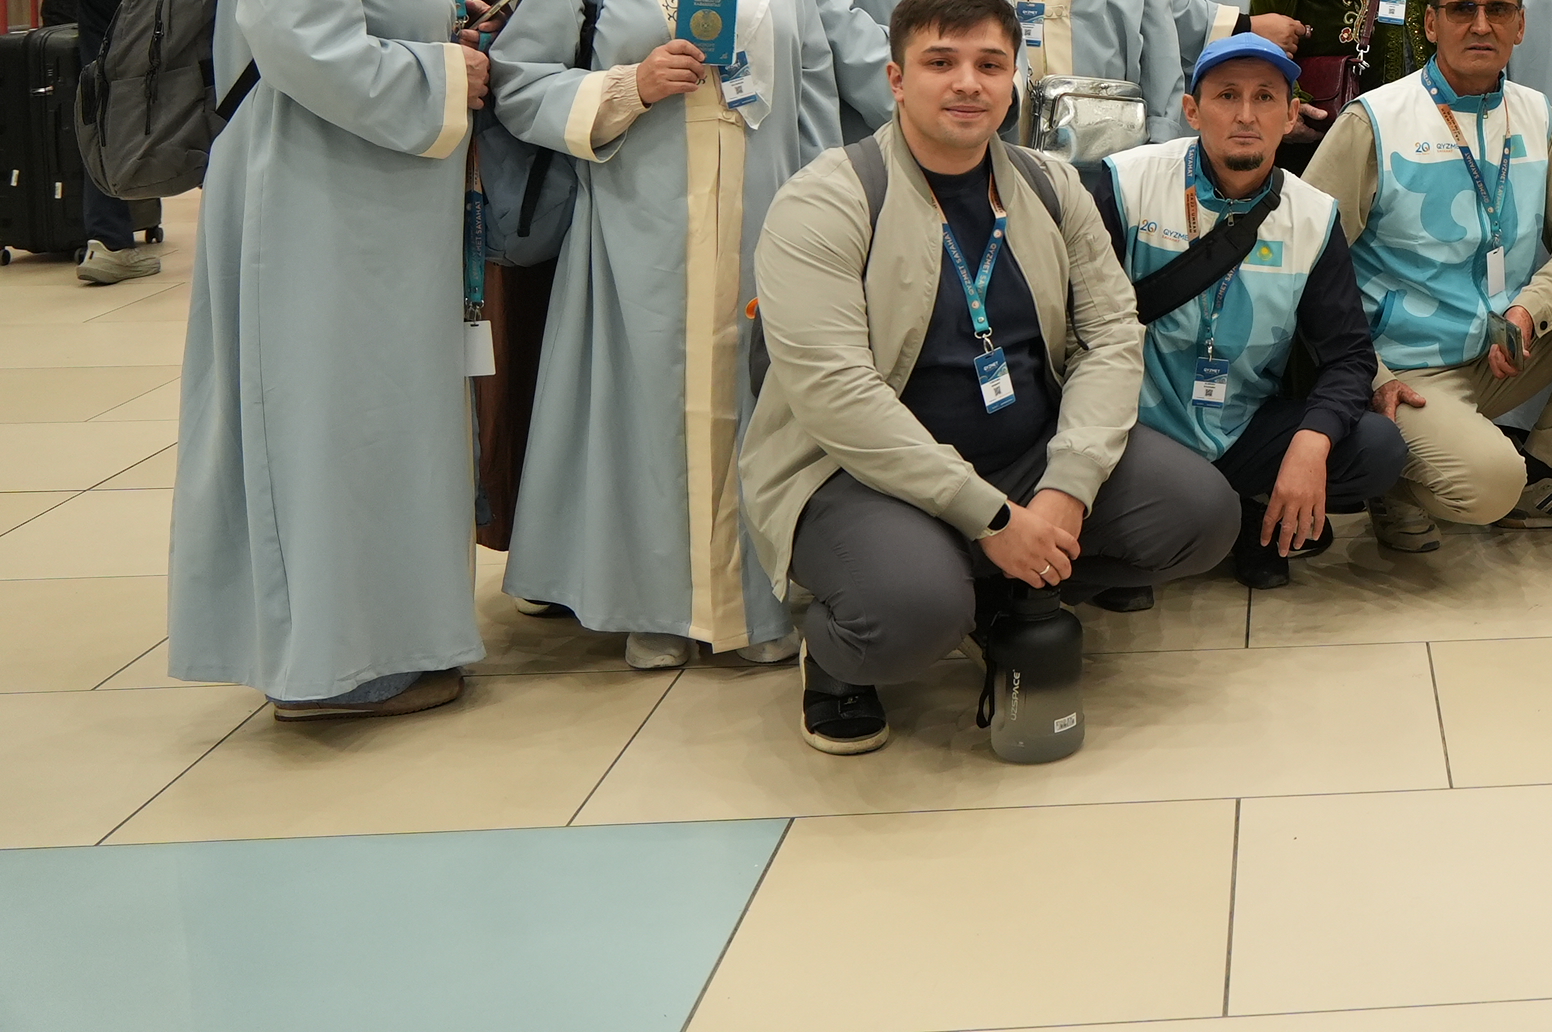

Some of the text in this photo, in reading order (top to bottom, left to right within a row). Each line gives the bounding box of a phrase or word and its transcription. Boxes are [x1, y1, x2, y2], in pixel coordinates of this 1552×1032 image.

[1187, 149, 1195, 177] SAYAHAT
[1465, 152, 1490, 203] QYZMET SAYAHAT
[1163, 228, 1189, 241] QYZME
[943, 231, 975, 295] QYZMET SAYAHAT
[982, 243, 997, 273] QYZMET
[1216, 282, 1228, 308] QYZMET
[1011, 672, 1020, 721] UZSPACE
